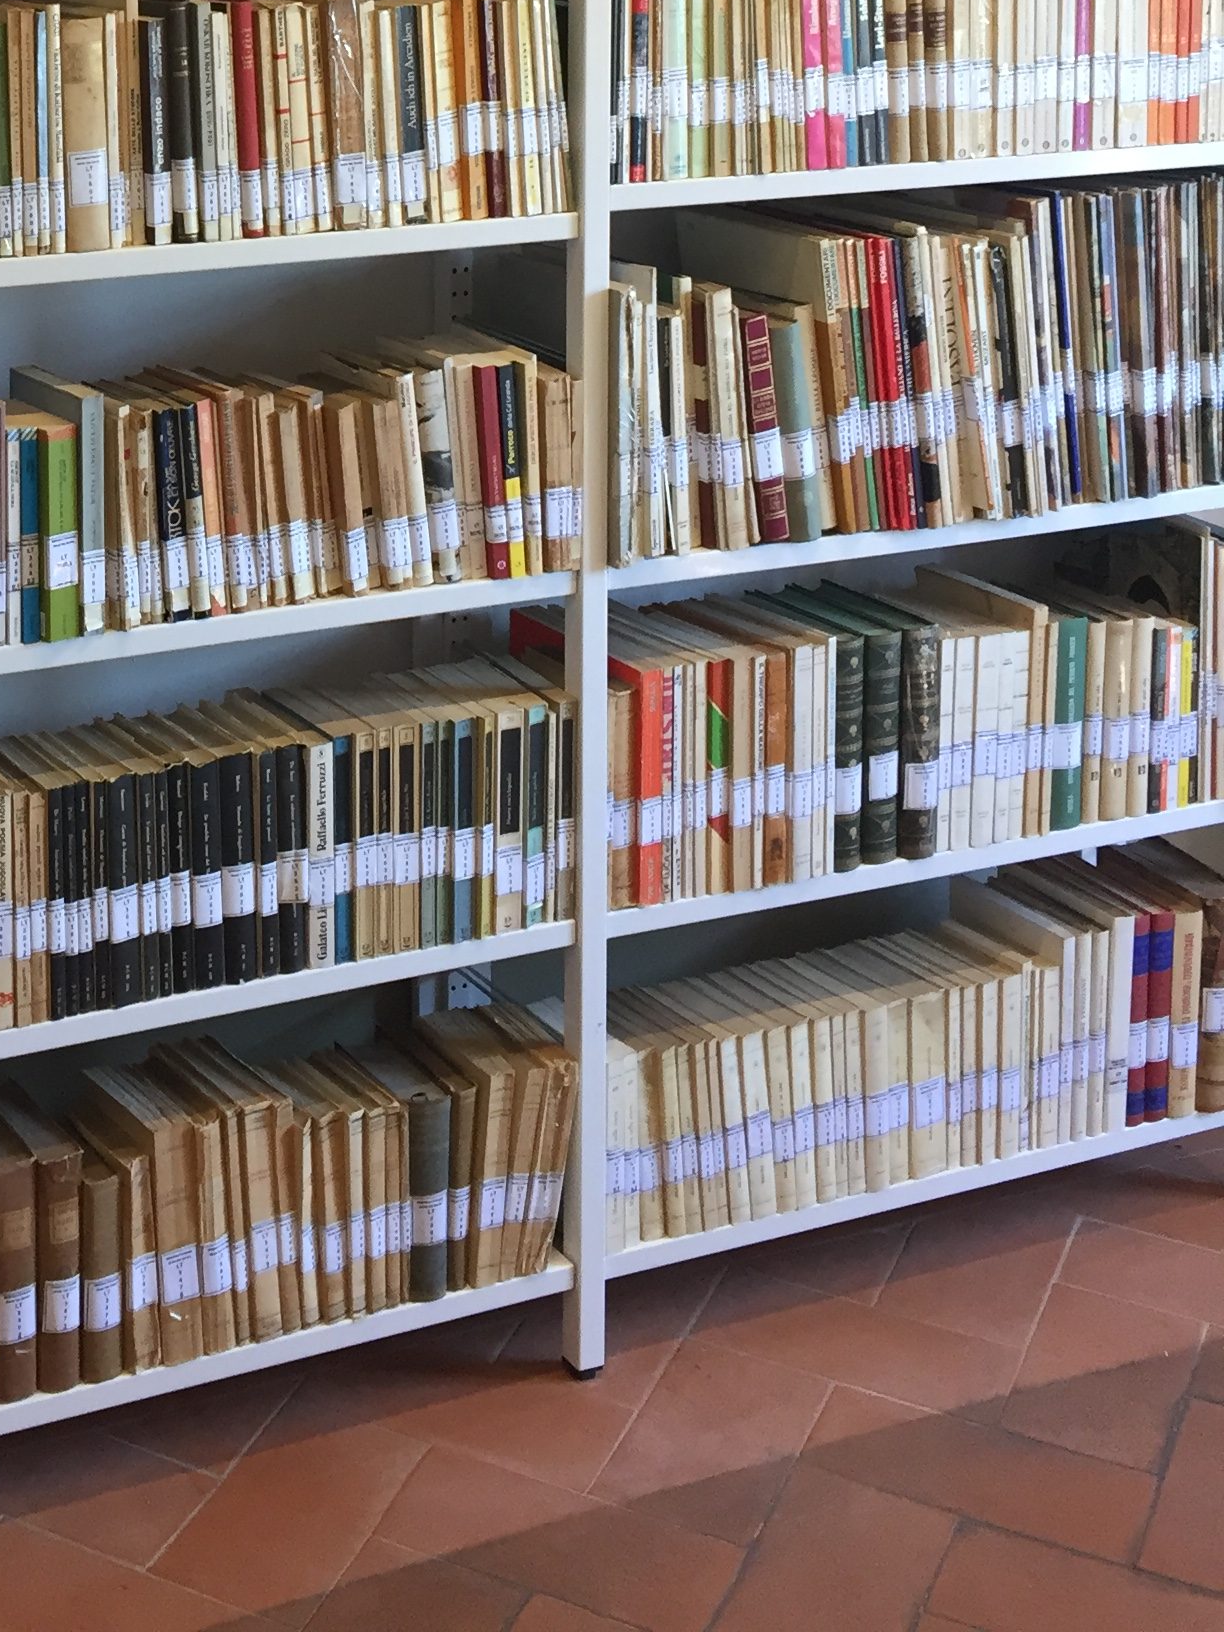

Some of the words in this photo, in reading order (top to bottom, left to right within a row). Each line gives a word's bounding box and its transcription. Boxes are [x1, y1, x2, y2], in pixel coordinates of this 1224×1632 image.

[154, 96, 163, 135] indaco
[316, 762, 327, 805] Ferruzzi
[316, 921, 328, 961] Galateo
